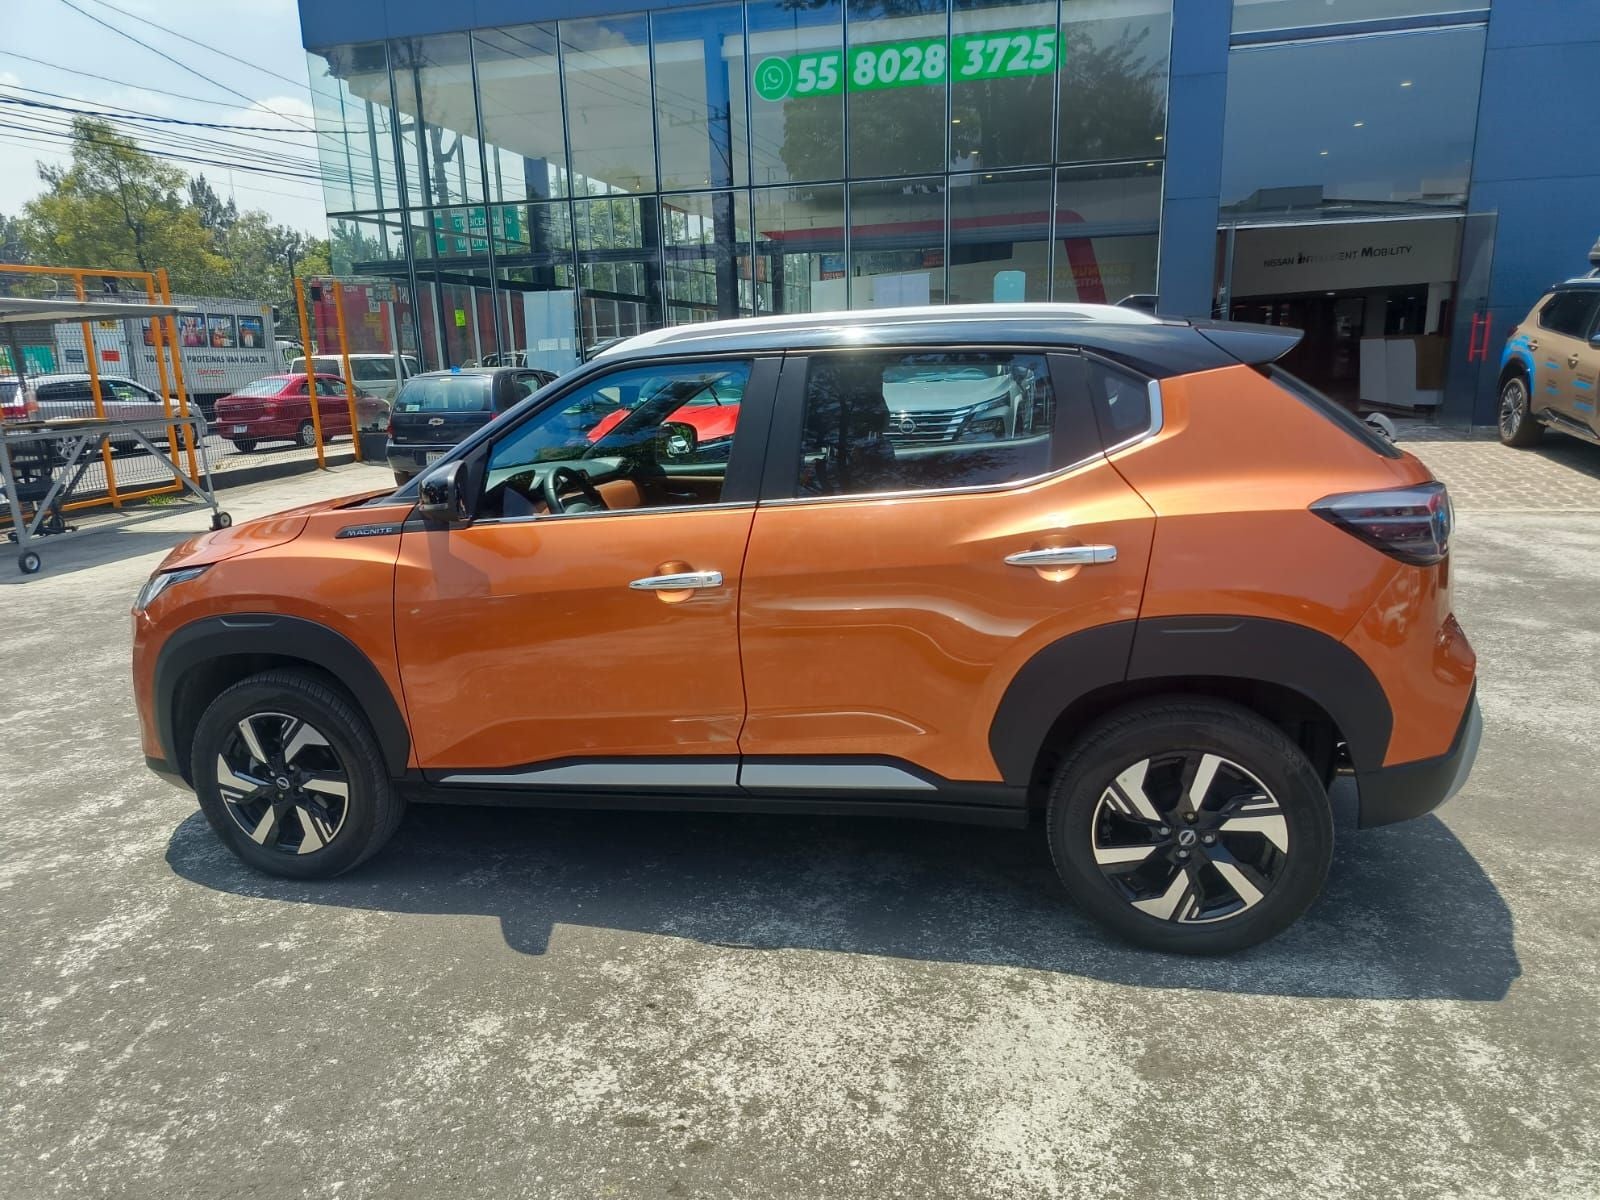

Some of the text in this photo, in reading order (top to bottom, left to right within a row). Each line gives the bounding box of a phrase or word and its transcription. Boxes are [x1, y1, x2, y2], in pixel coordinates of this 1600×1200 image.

[796, 33, 1056, 92] 55 8028 3725
[1264, 245, 1413, 268] NISSAN INTENT MOBILITY
[144, 354, 170, 363] TOS
[346, 527, 393, 537] MAGNITE
